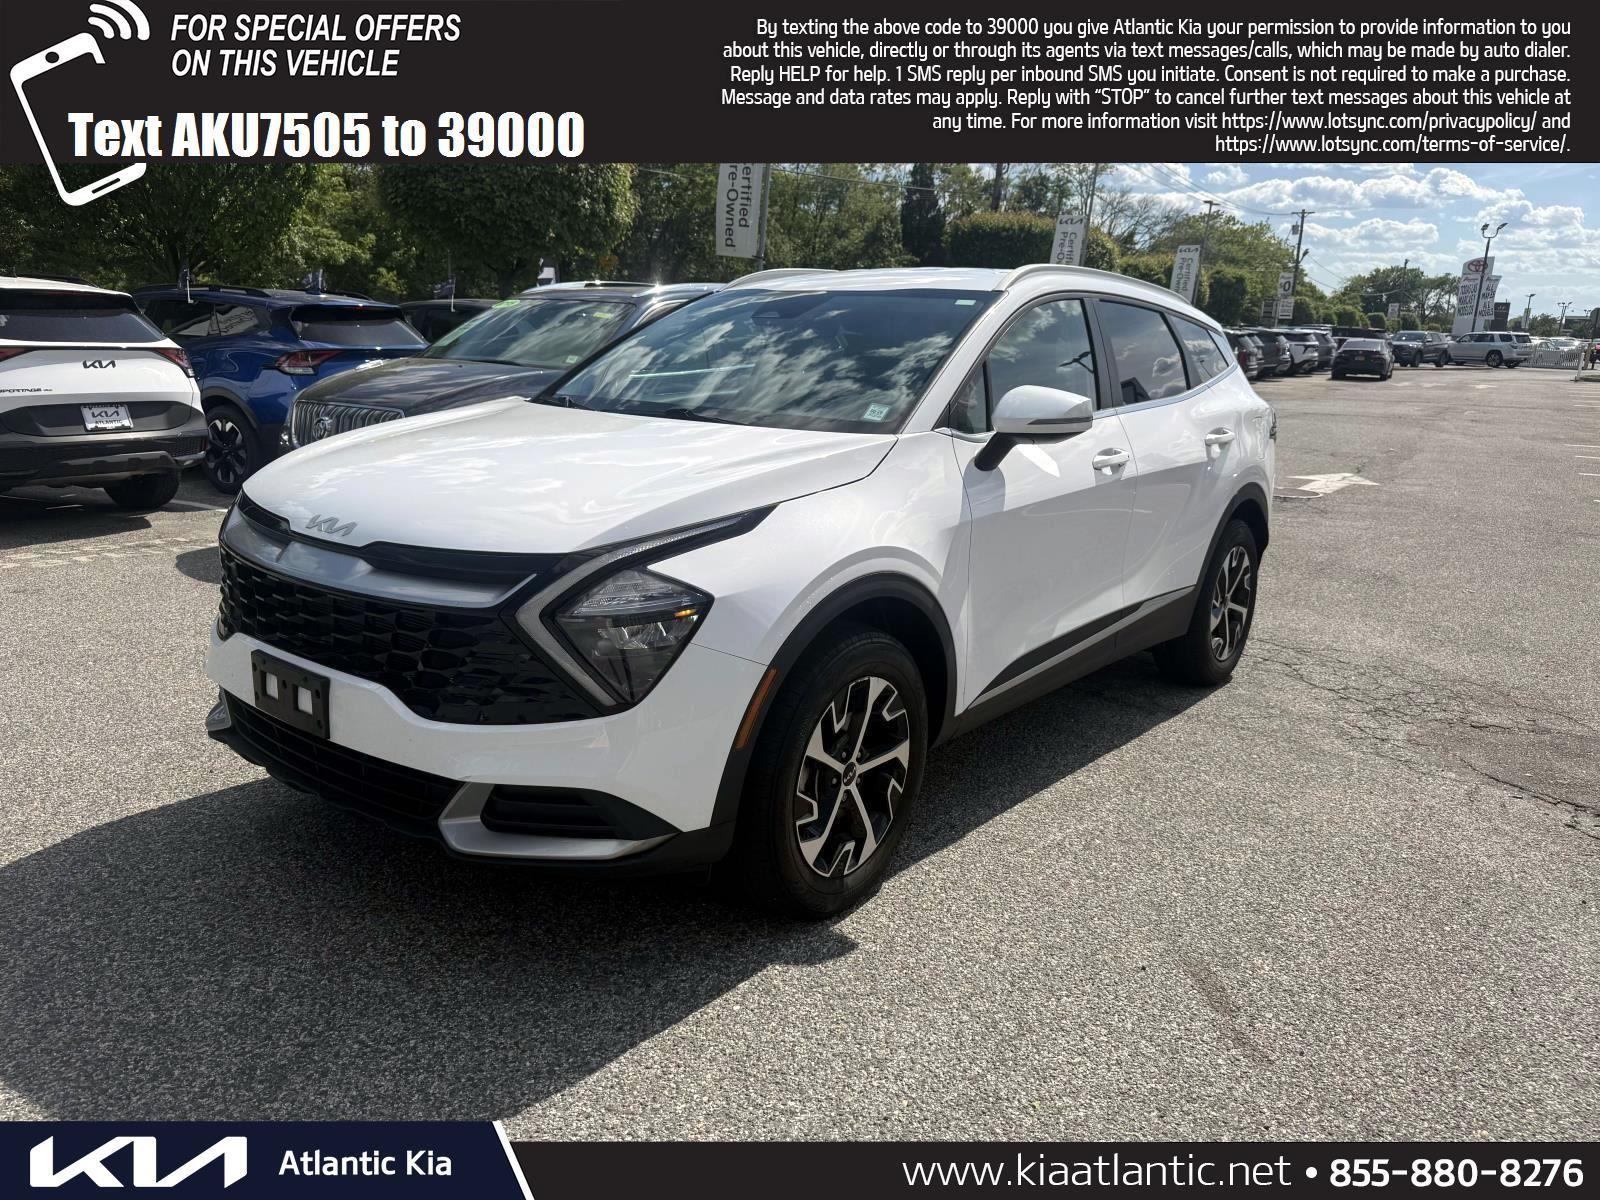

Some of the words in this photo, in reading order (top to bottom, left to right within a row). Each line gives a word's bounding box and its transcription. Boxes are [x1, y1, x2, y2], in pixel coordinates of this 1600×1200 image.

[725, 163, 739, 248] re-Owned
[739, 163, 753, 228] ertified
[1065, 232, 1078, 265] Certifi
[82, 360, 117, 369] KIA
[91, 410, 120, 418] KIA
[305, 514, 358, 537] KIA
